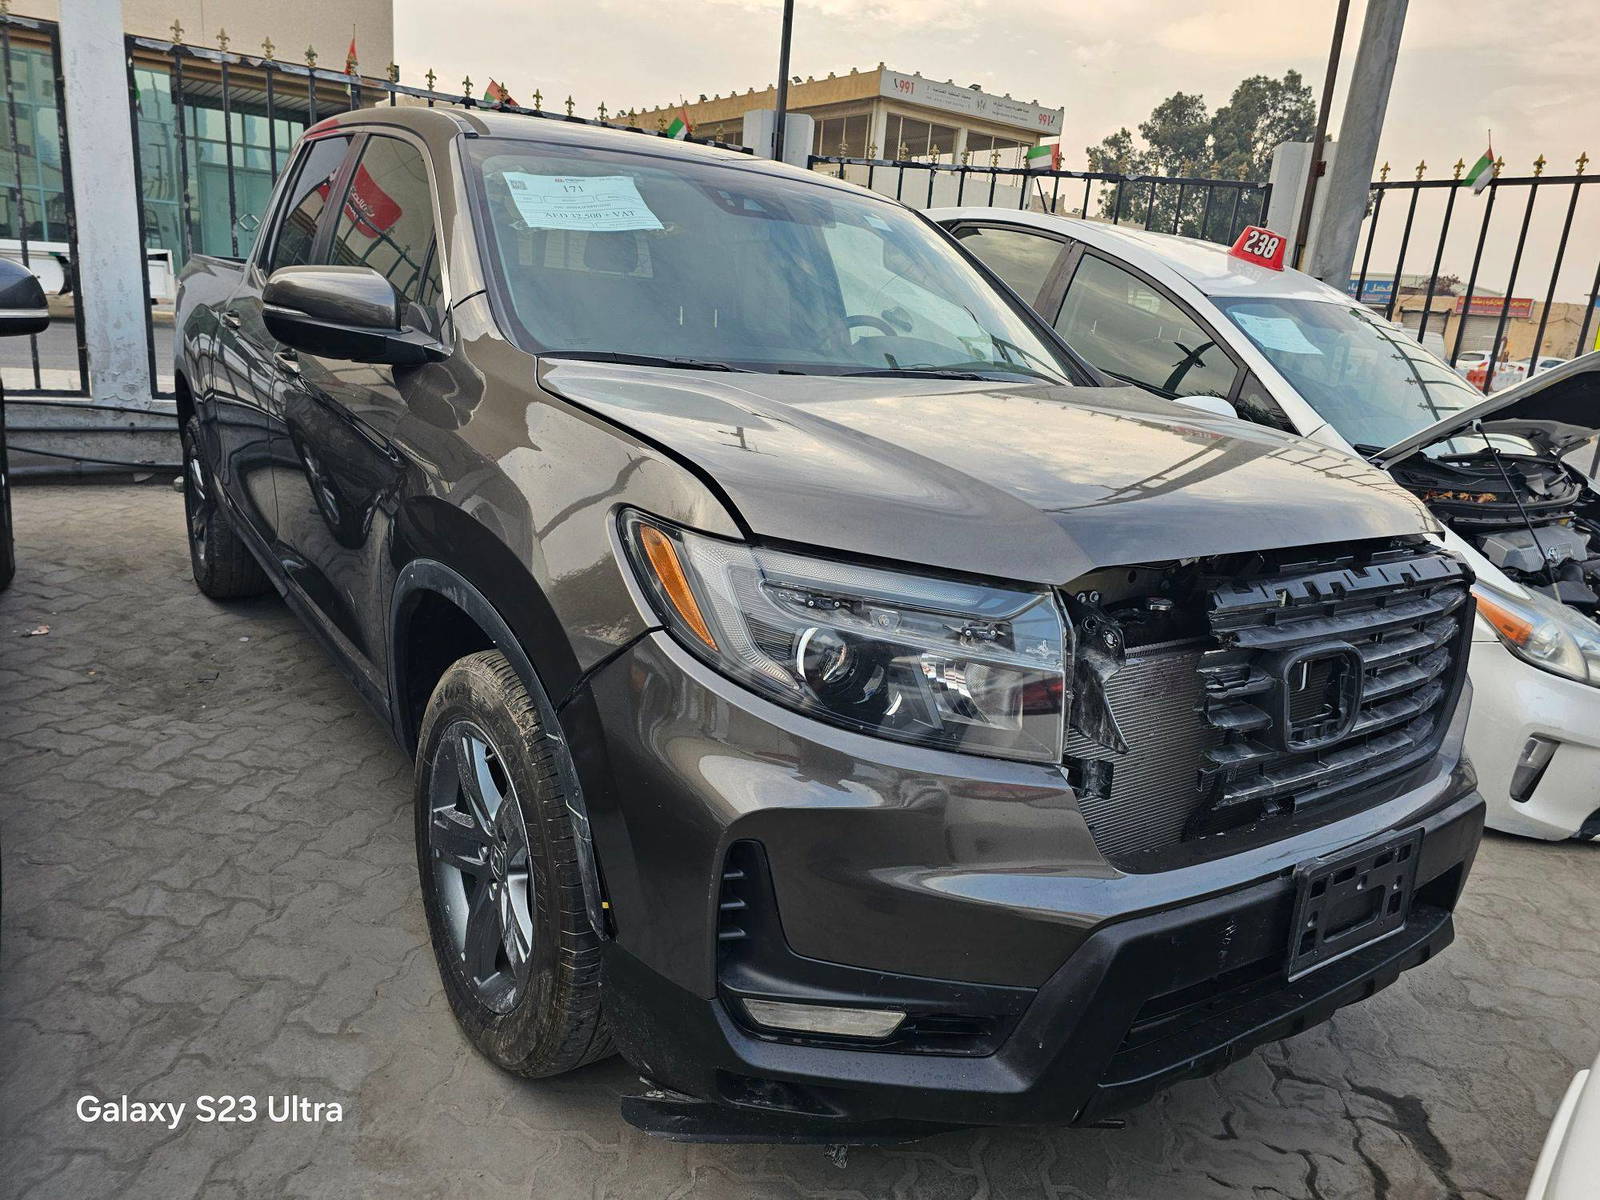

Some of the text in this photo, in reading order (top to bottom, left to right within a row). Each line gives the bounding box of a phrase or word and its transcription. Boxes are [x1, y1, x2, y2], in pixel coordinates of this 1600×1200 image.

[899, 80, 915, 95] 991
[1038, 113, 1051, 126] 991
[563, 185, 584, 193] 171
[1242, 230, 1280, 259] 238
